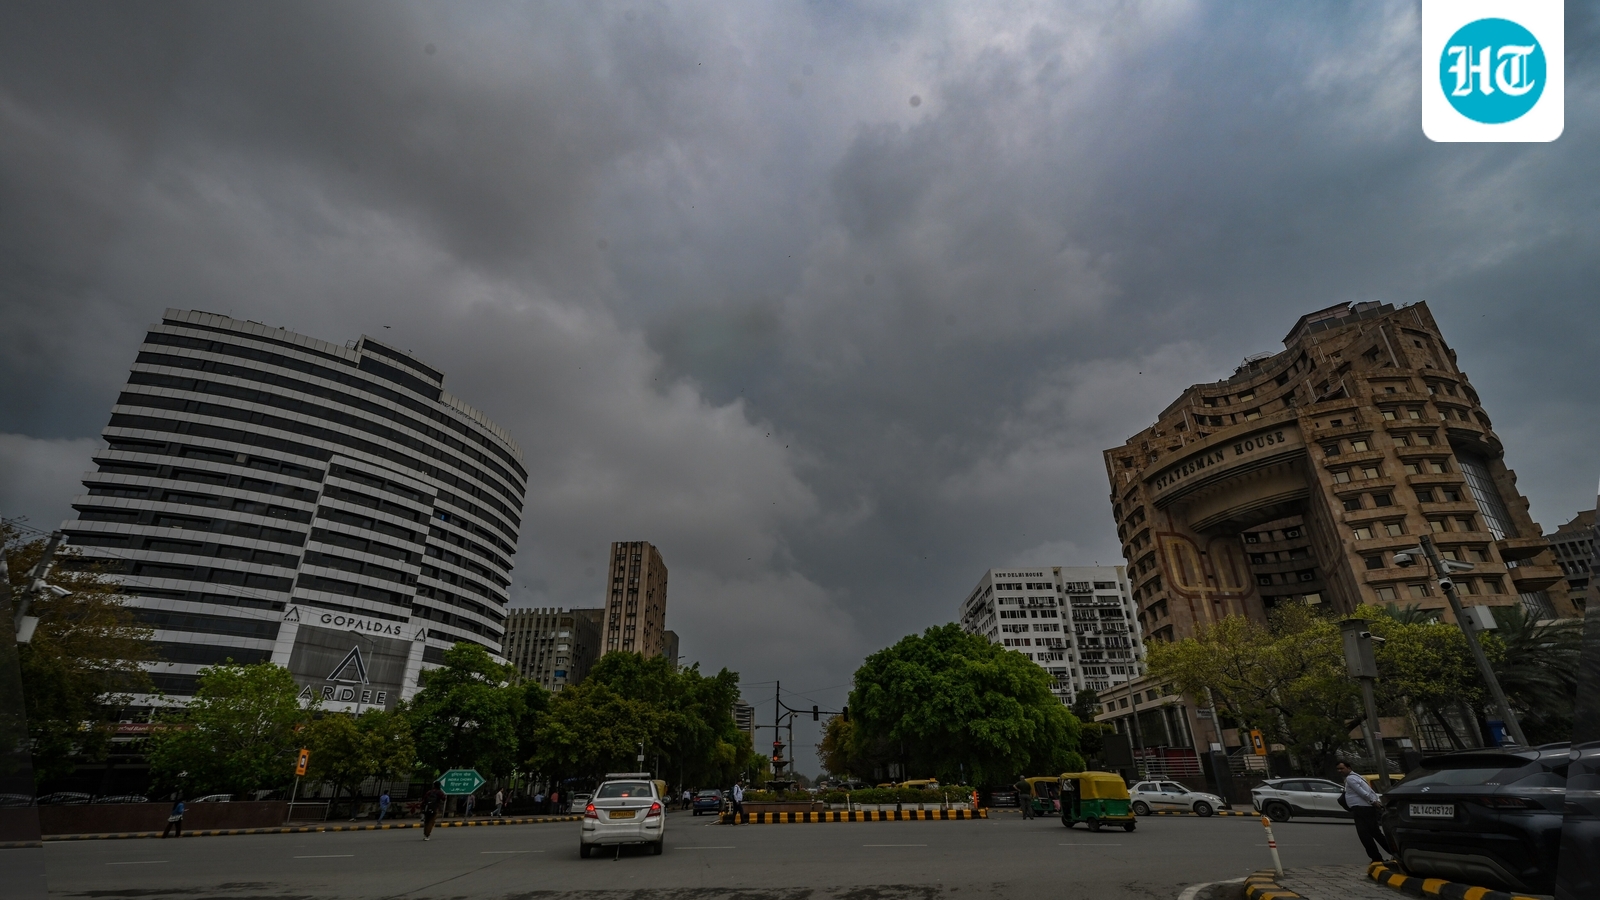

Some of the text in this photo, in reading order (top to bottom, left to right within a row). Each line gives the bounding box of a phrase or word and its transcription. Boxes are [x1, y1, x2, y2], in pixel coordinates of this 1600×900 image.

[1156, 430, 1286, 491] STATESMAN HOUSE
[320, 613, 402, 636] GOPALDAS
[297, 684, 387, 706] ARDEE
